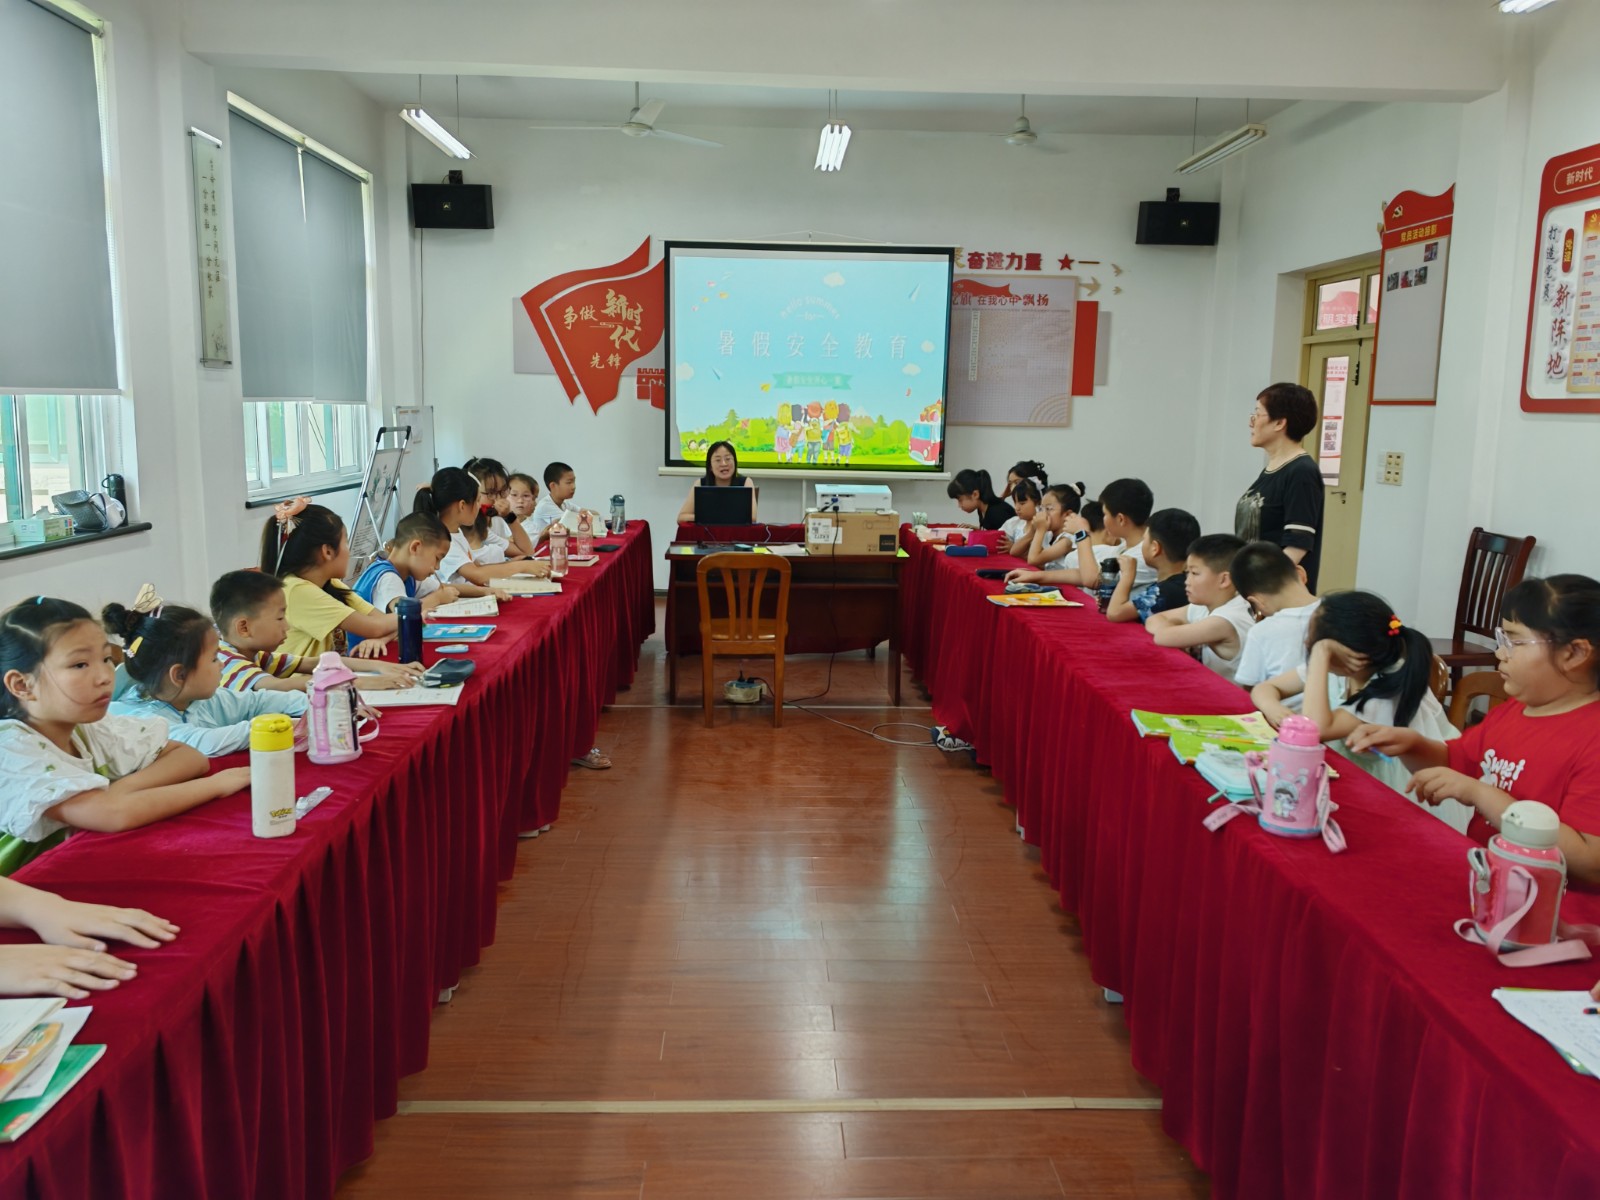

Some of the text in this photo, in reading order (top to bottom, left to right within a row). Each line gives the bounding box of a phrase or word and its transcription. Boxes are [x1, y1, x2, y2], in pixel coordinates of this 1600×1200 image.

[1566, 167, 1594, 186] 新时代
[564, 288, 644, 352] 争做 新时代
[1547, 284, 1570, 375] 新阵地
[719, 330, 907, 359] 暑假安全教育
[590, 352, 621, 369] 先锋
